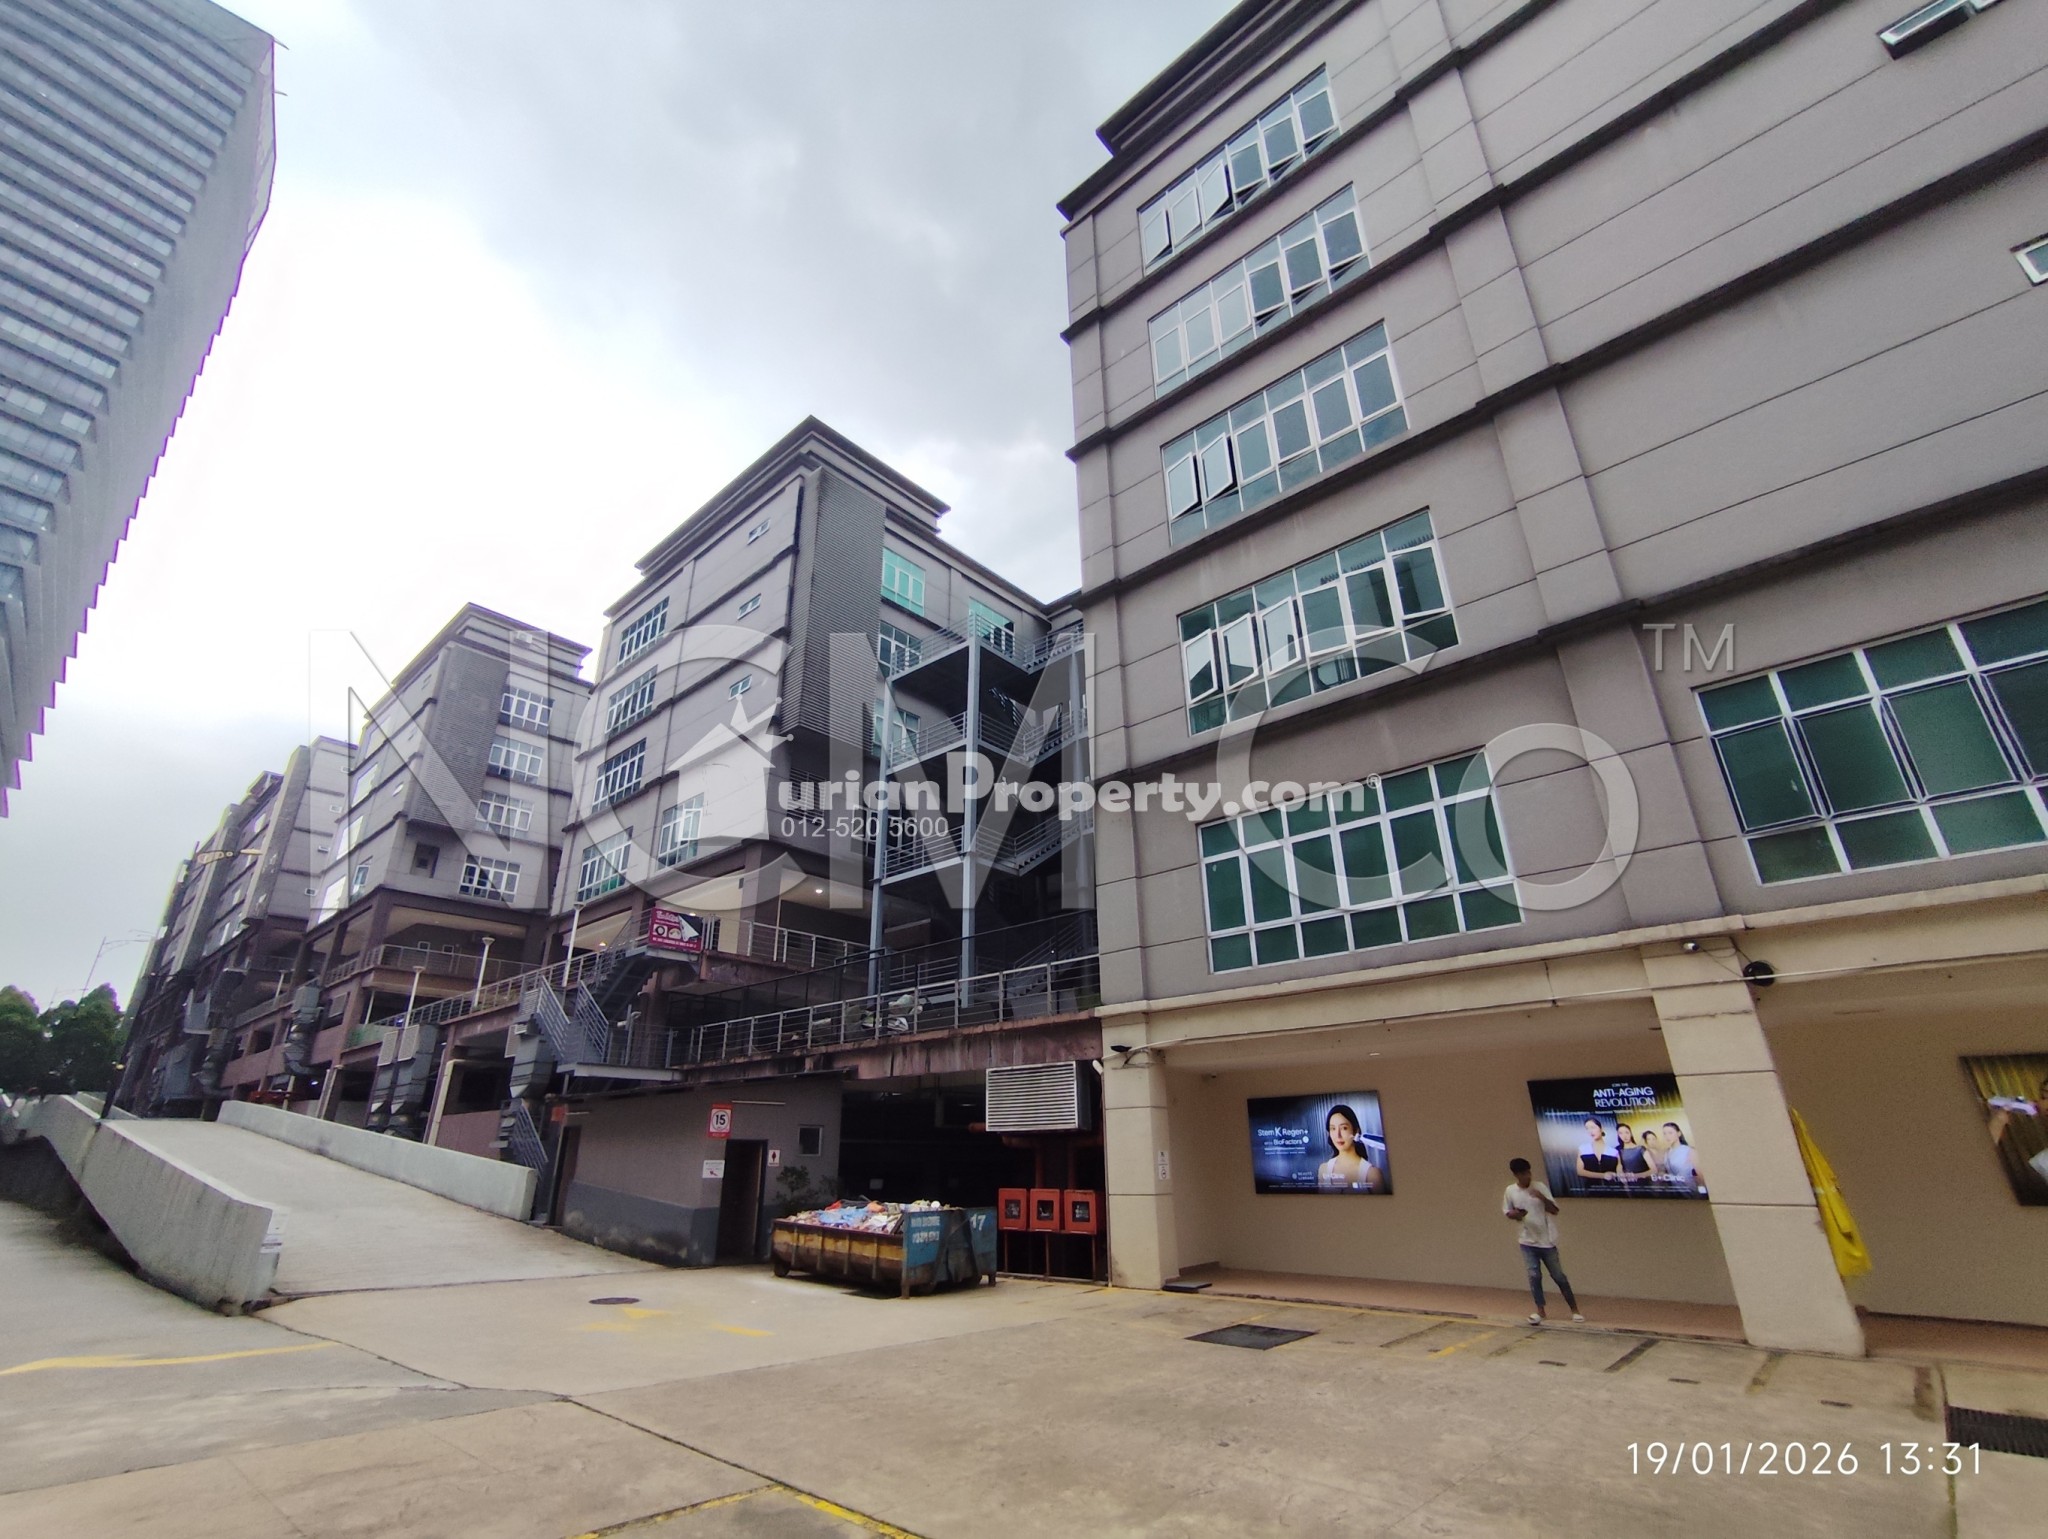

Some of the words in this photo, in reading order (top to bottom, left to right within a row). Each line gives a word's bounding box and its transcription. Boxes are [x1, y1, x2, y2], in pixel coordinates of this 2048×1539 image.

[1593, 1086, 1654, 1098] ANTI-AGING
[1594, 1096, 1656, 1108] REVOLUTION
[715, 1114, 726, 1126] 15
[1257, 1128, 1275, 1137] Stem
[1273, 1138, 1303, 1146] BioFactors
[969, 1213, 987, 1232] 17
